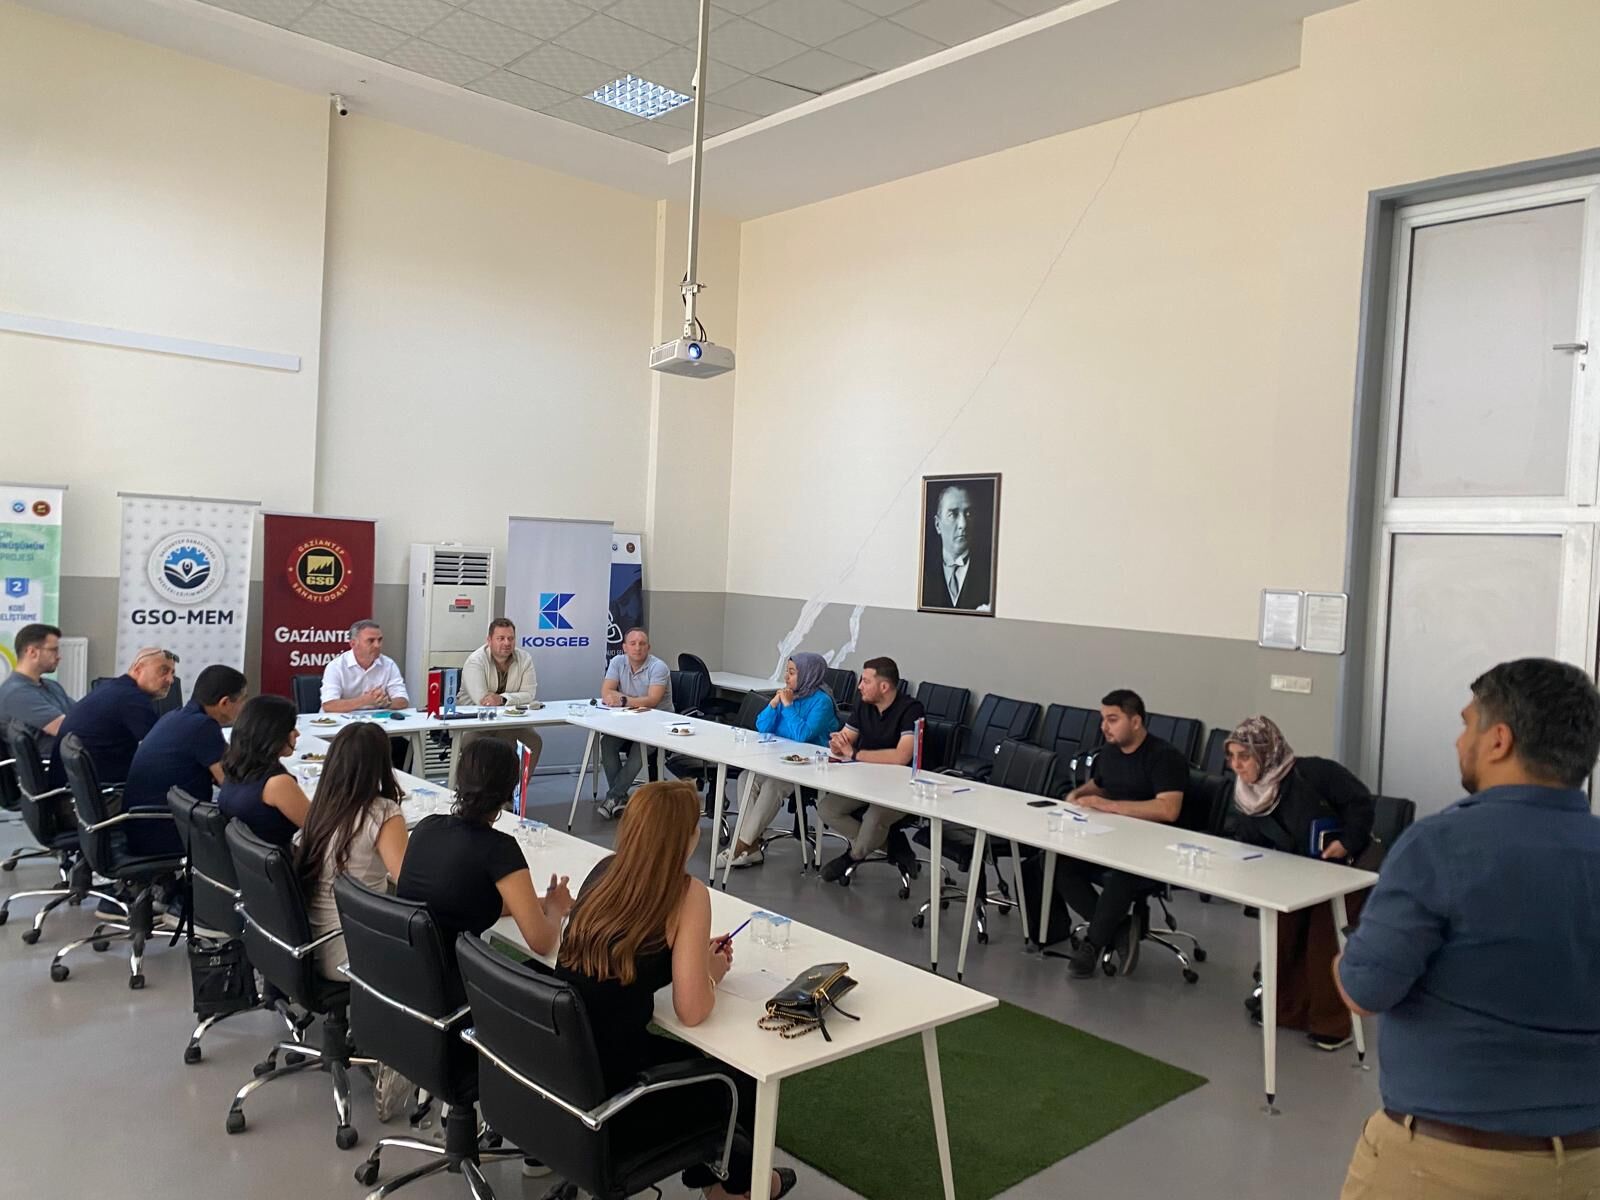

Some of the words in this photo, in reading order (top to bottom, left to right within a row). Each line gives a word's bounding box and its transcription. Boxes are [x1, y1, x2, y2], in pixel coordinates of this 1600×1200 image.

[12, 581, 22, 592] 2
[306, 576, 335, 586] GSO
[131, 609, 234, 625] GSO-MEM
[275, 626, 351, 643] GAZİANTE
[521, 636, 590, 647] KOSGEB
